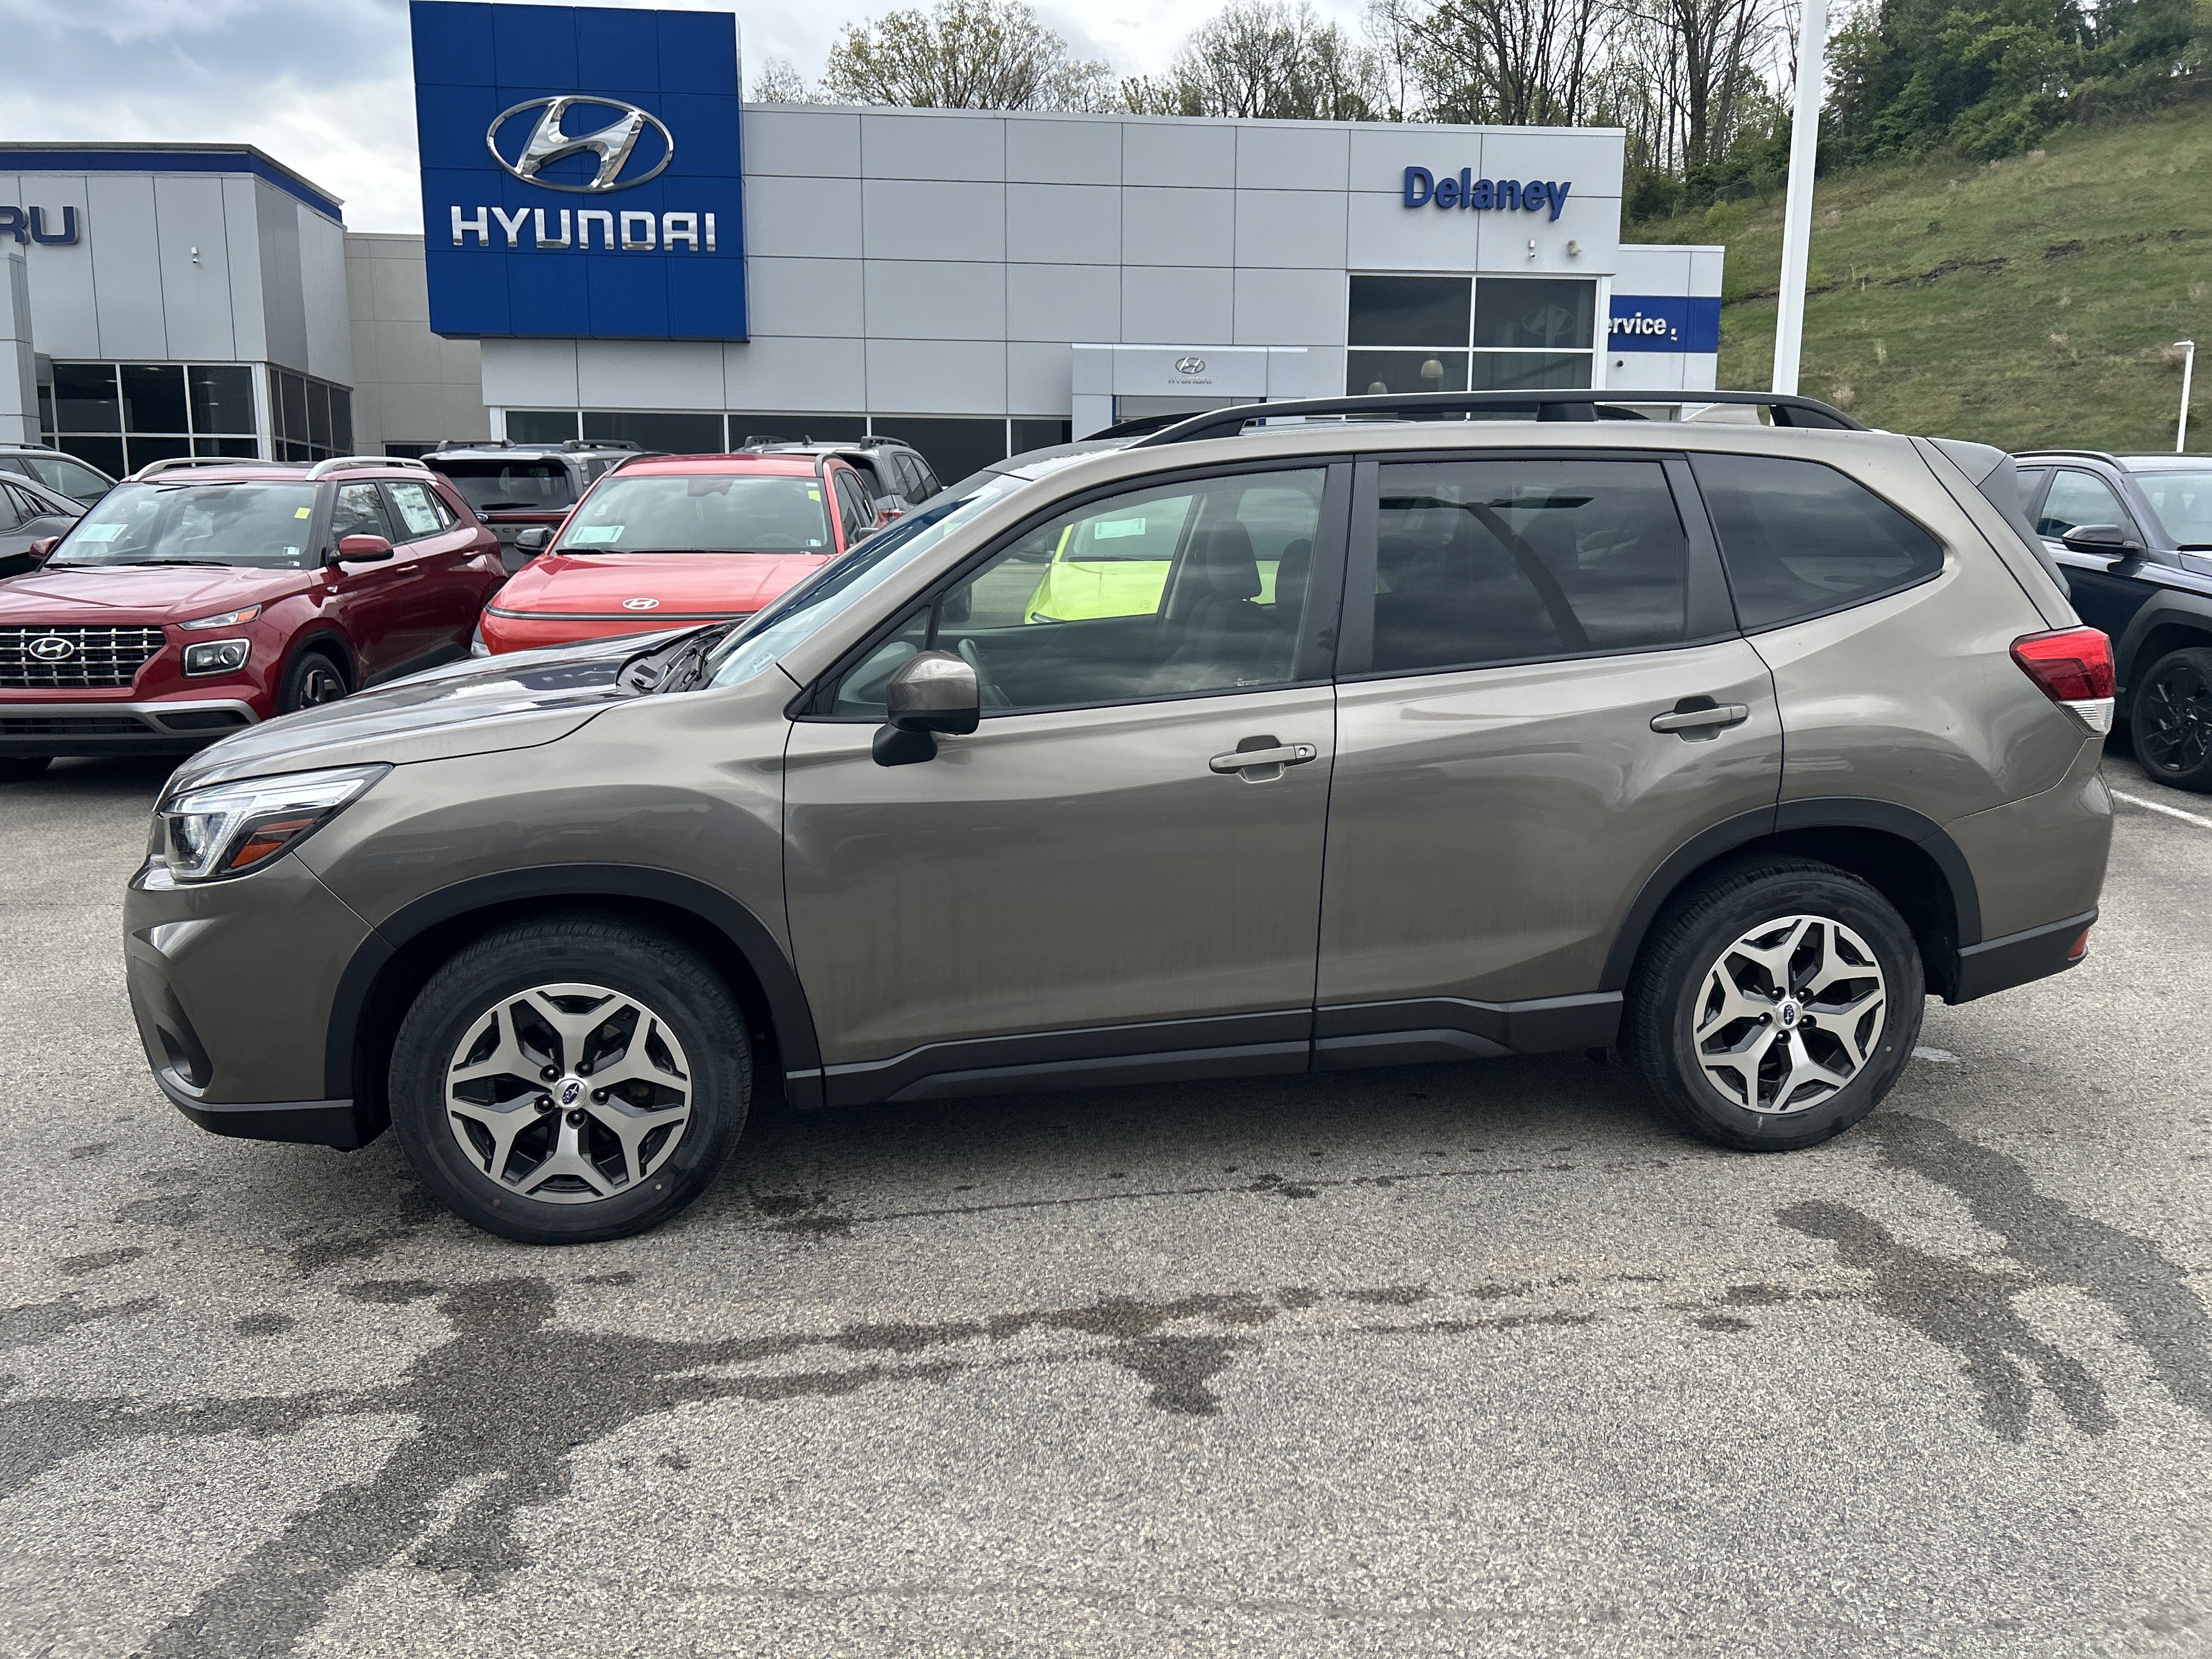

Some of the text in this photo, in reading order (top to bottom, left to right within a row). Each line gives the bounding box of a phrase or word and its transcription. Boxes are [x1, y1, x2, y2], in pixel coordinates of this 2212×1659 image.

[1404, 166, 1572, 221] Delaney
[0, 206, 77, 244] RU
[450, 206, 716, 252] HYUNDAI
